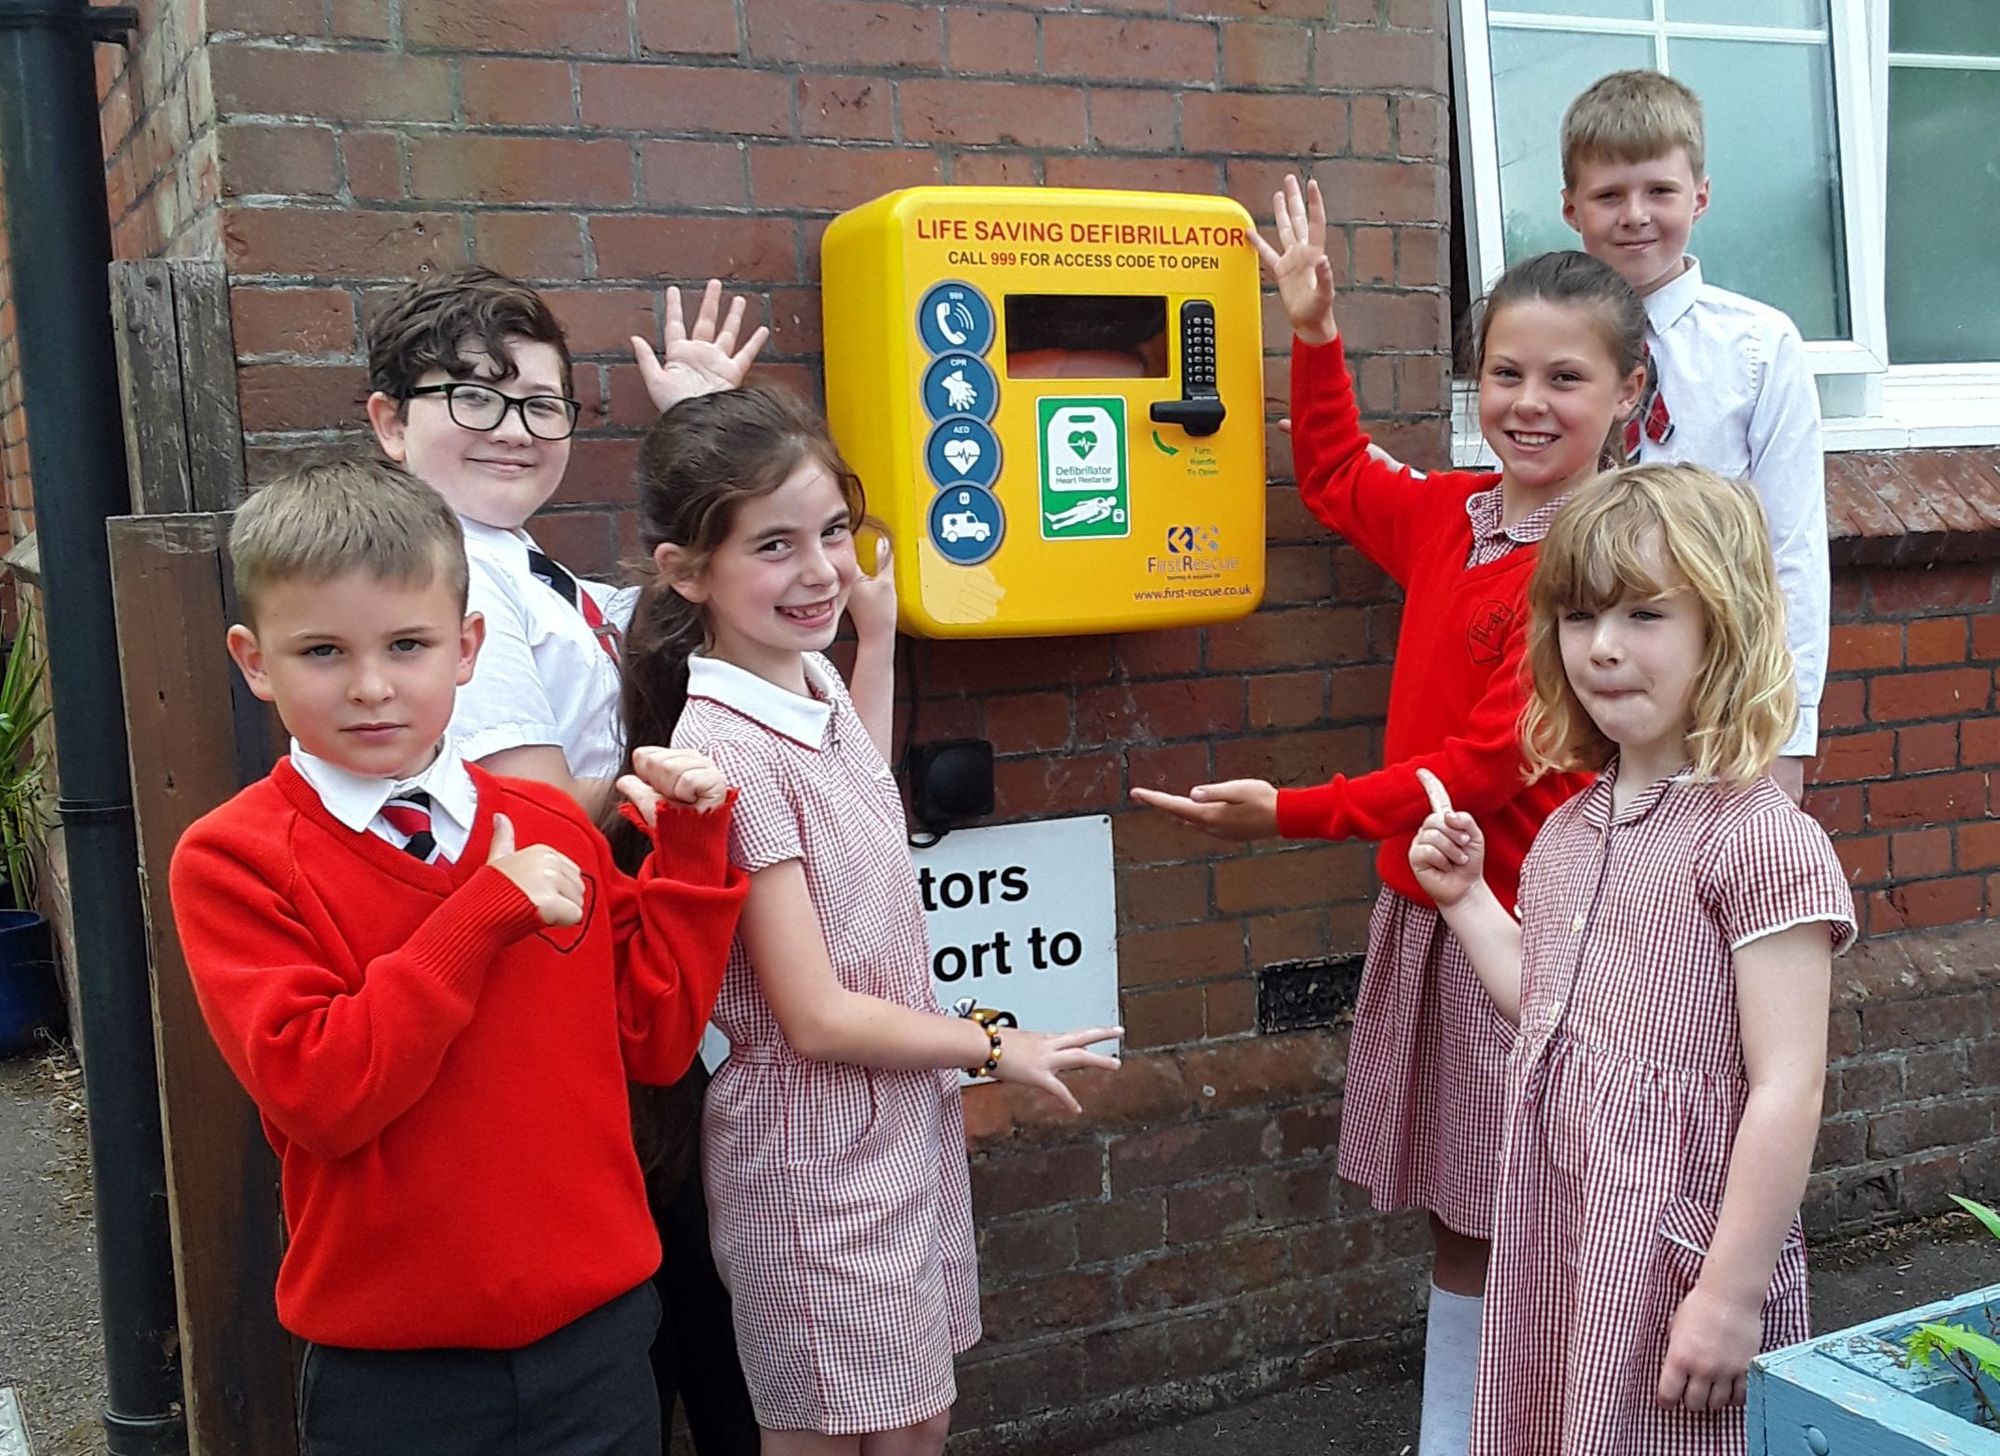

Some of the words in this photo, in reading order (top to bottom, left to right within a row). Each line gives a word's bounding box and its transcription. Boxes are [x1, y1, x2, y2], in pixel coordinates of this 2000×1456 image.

[917, 218, 968, 240] LIFE
[974, 220, 1063, 243] SAVING
[1070, 223, 1244, 247] DEFIBRILLATOR
[948, 251, 987, 265] CALL
[991, 252, 1016, 266] 999
[1020, 252, 1050, 266] FOR
[1054, 253, 1112, 267] ACCESS
[1116, 254, 1155, 268] CODE
[1159, 255, 1178, 269] TO
[1181, 256, 1219, 269] OPEN
[950, 358, 967, 367] CPR
[953, 425, 970, 434] AED
[1055, 465, 1112, 476] Defibrillator
[1055, 477, 1077, 485] Heart
[1078, 476, 1112, 484] Restarter
[1133, 583, 1252, 600] www.first-rescue.co.uk
[918, 865, 1029, 912] tors
[932, 931, 1012, 982] ort
[1027, 926, 1082, 970] to
